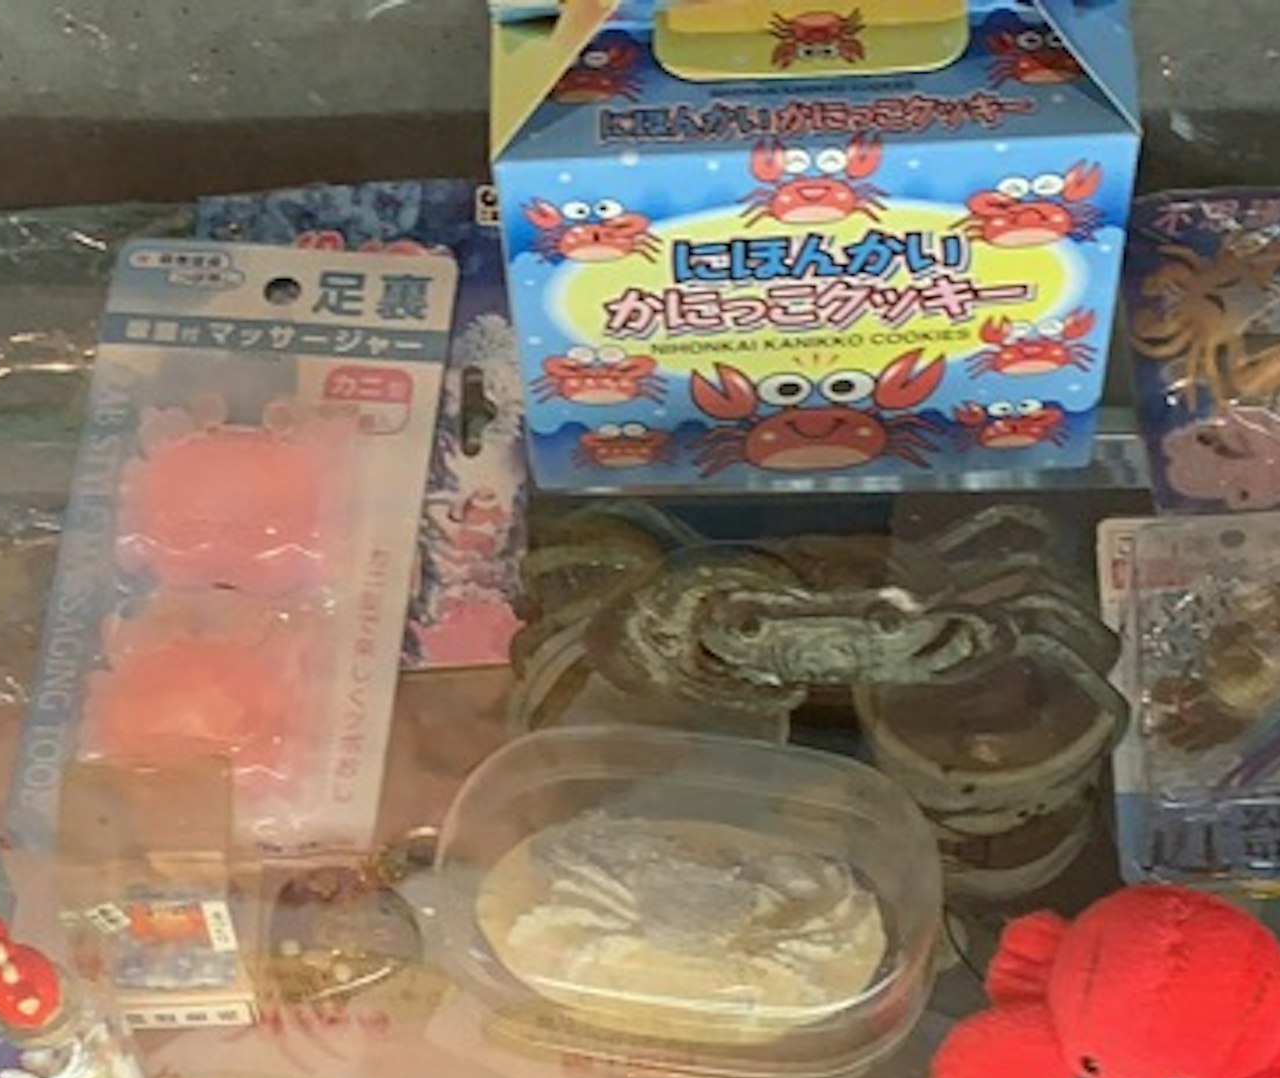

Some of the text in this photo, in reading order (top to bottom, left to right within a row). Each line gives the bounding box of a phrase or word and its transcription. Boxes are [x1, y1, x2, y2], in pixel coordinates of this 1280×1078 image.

[671, 229, 972, 286] にほんかい
[312, 270, 433, 320] 足裏
[604, 274, 1039, 341] かにっこクッキー
[651, 327, 971, 355] NIHONKAI KANIKKO COOKIES
